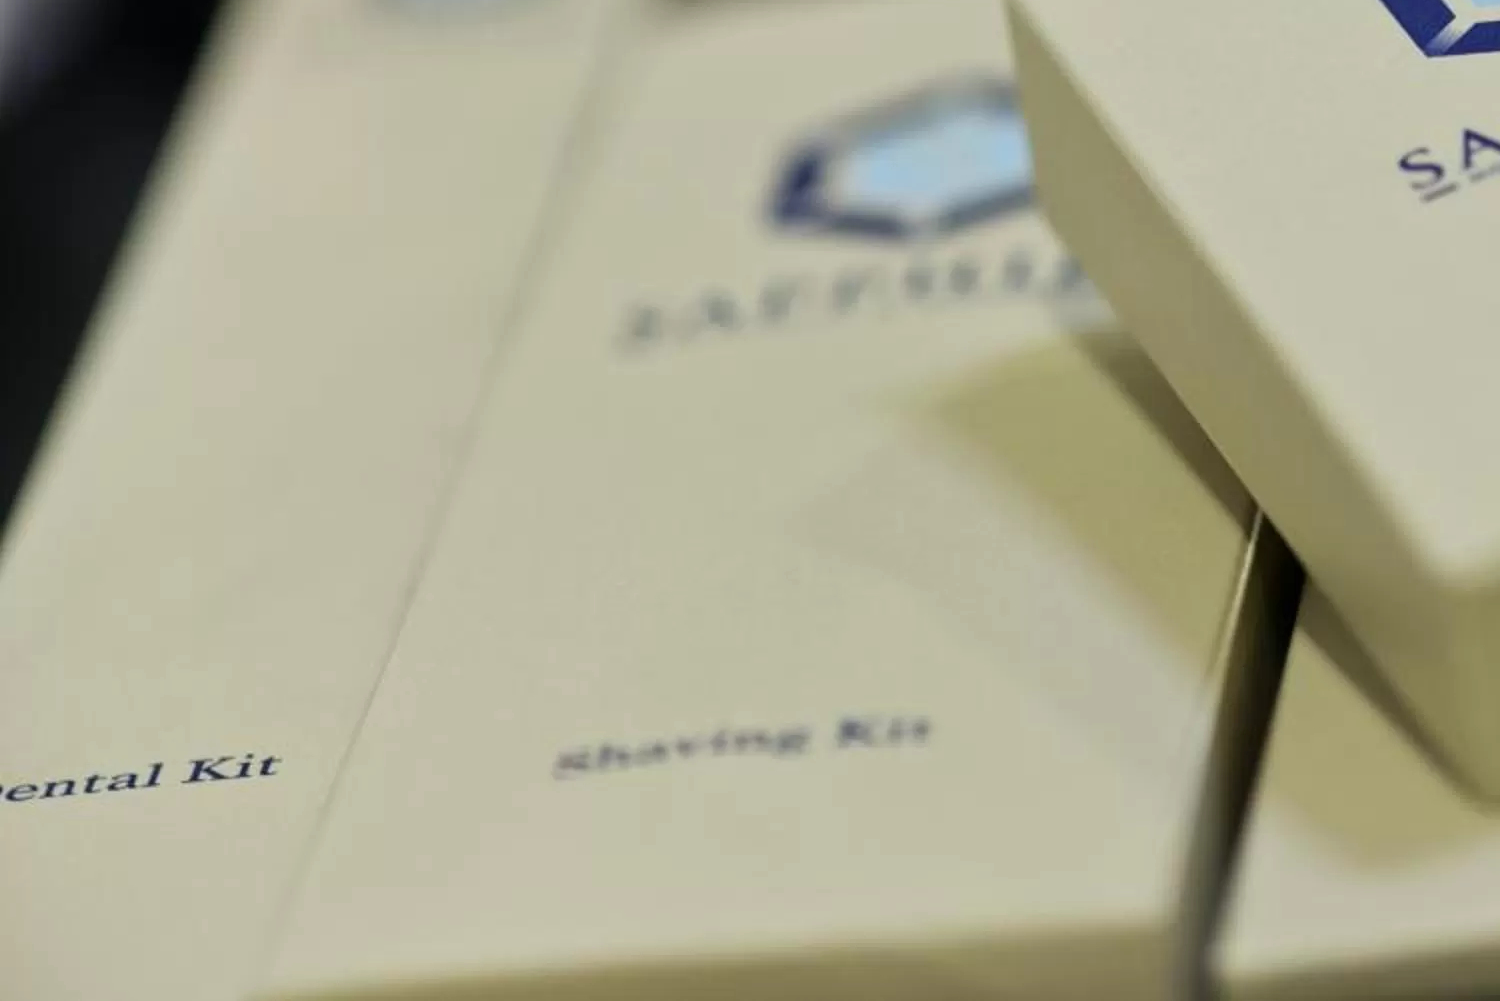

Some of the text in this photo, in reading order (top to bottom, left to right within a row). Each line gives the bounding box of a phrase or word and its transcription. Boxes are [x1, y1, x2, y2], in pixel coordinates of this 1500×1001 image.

[552, 713, 934, 781] Shaving Kit
[0, 752, 284, 802] ental Kit
